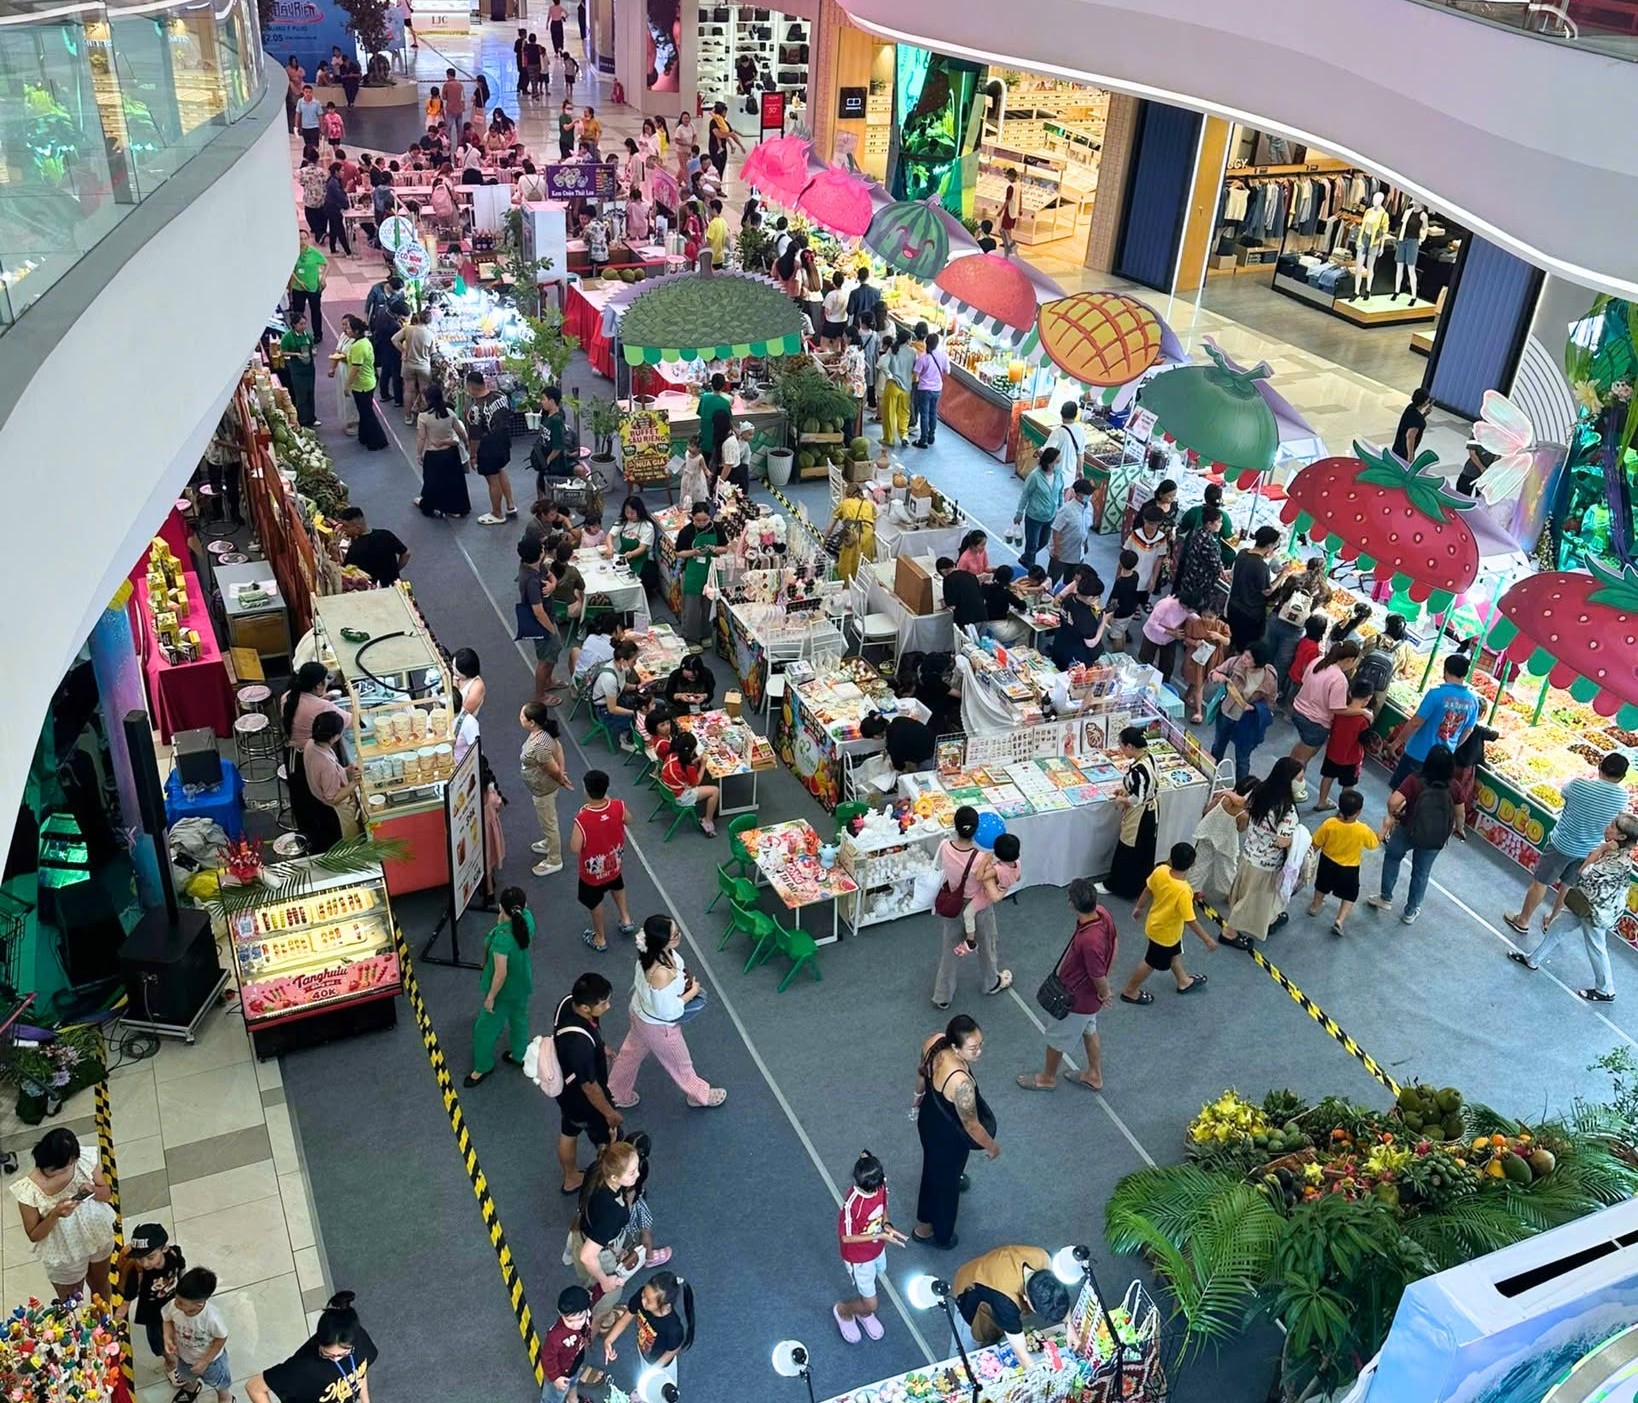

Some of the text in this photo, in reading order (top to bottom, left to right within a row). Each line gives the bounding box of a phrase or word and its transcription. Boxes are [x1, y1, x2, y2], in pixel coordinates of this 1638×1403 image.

[629, 427, 660, 438] BUFFET
[1497, 797, 1546, 846] DẺO
[312, 988, 336, 1000] 40K
